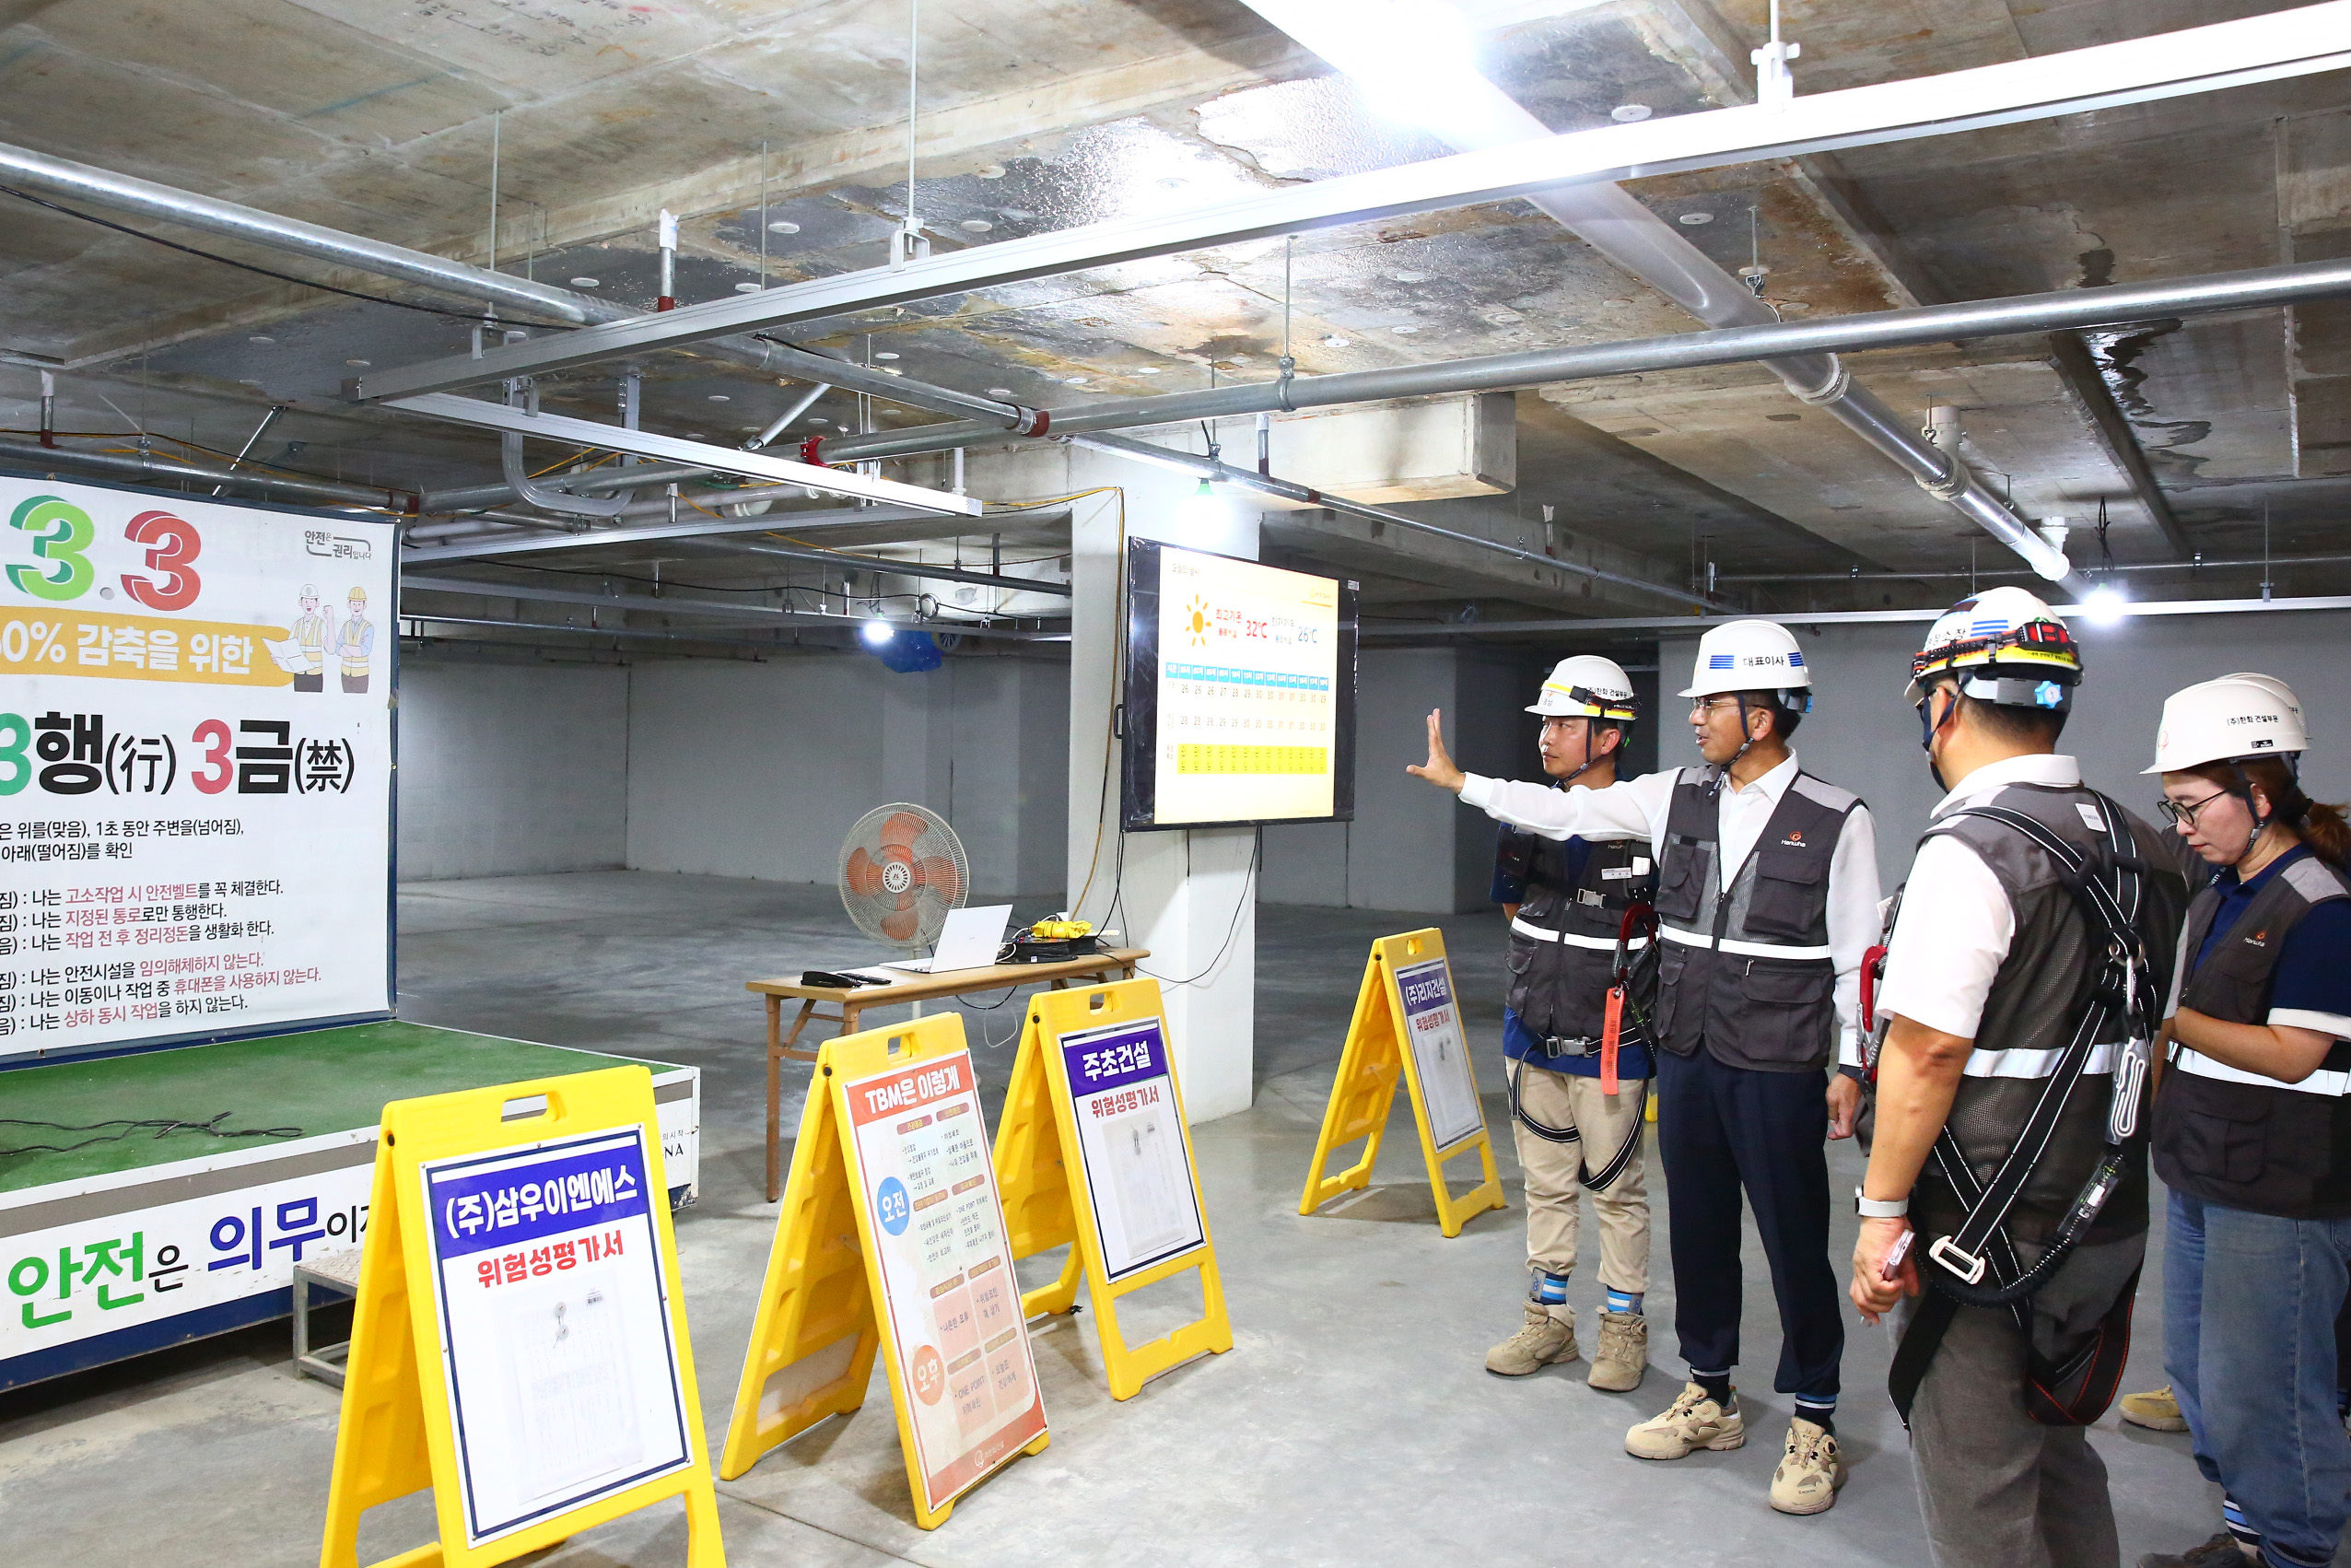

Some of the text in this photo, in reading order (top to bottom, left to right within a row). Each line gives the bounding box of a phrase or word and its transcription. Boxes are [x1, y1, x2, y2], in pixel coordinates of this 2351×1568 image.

[304, 531, 332, 545] 안전은
[333, 544, 371, 560] 권리입니다
[0, 619, 253, 674] 0% 감축을 위한
[1743, 655, 1784, 667] 대표이사
[2227, 715, 2278, 726] (주)한화 건설부문
[18, 820, 90, 839] 위를(맞음),
[97, 821, 119, 837] 1초
[123, 820, 149, 837] 동안
[153, 818, 244, 837] 주변을(넘어짐),
[1781, 838, 1806, 848] Hanwha
[2, 842, 133, 862] 아래(떨어짐)를 확인
[32, 889, 62, 907] 나는
[65, 886, 124, 904] 고소작업
[128, 885, 142, 902] 시
[146, 883, 211, 902] 안전벨트를
[215, 882, 228, 897] 꼭
[231, 879, 284, 896] 체결한다.
[32, 911, 62, 929] 나는
[65, 908, 109, 927] 지정된
[112, 906, 169, 925] 통로로만
[172, 903, 228, 921] 통행한다.
[32, 933, 62, 952] 나는
[65, 930, 93, 949] 작업
[99, 930, 111, 947] 전
[116, 929, 130, 946] 후
[135, 924, 201, 945] 정리정돈을
[205, 922, 243, 940] 생활화
[247, 920, 275, 936] 한다.
[31, 968, 61, 986] 나는
[64, 961, 135, 983] 안전시설을
[140, 955, 219, 977] 임의해체하지
[223, 952, 263, 971] 않는다.
[30, 990, 60, 1009] 나는
[64, 984, 122, 1005] 이동이나
[125, 980, 152, 1000] 작업
[157, 980, 170, 998] 중
[173, 975, 226, 996] 휴대폰을
[229, 970, 279, 989] 사용하지
[283, 966, 322, 986] 않는다.
[30, 1012, 60, 1031] 나는
[64, 1008, 94, 1028] 상하
[98, 1005, 126, 1024] 동시
[131, 1000, 172, 1020] 작업을
[175, 998, 202, 1016] 하지
[205, 994, 248, 1014] 않는다.
[1082, 1040, 1152, 1082] 주초건설
[864, 1064, 961, 1115] TBM은 이렇게
[1091, 1084, 1160, 1118] 위험성평가서
[446, 1162, 638, 1239] (주)삼우이엔에스
[882, 1190, 906, 1223] 오전
[477, 1228, 625, 1289] 위험성평가서
[8, 1230, 189, 1329] 안전은
[918, 1358, 939, 1394] 오후
